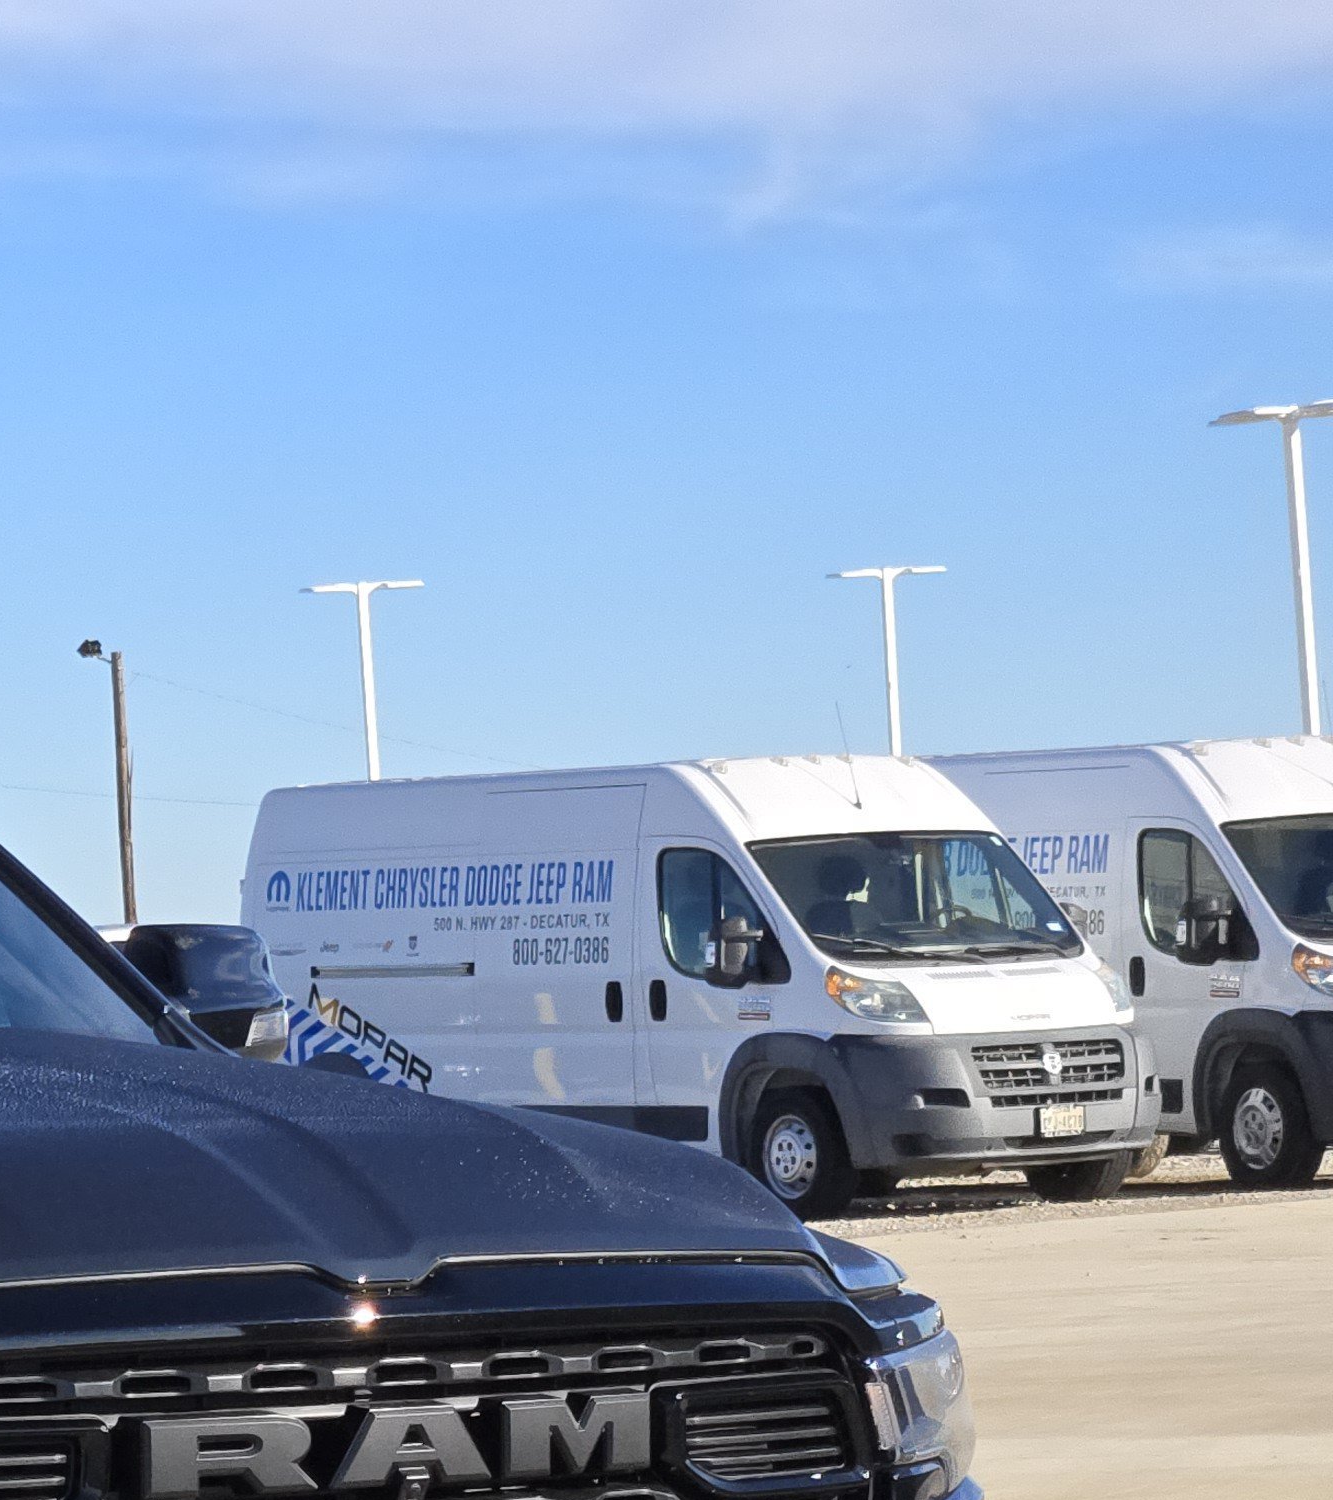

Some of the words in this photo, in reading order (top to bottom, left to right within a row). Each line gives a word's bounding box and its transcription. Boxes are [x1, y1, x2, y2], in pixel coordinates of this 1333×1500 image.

[1067, 834, 1109, 874] RAM
[296, 869, 370, 912] KLEMENT
[374, 866, 459, 910] CHRYSLER
[464, 863, 523, 906] DODGE
[527, 862, 566, 904] JEEP
[571, 860, 614, 903] RAM
[1046, 886, 1089, 900] ECATUR,
[1094, 886, 1106, 898] TX
[433, 917, 452, 931] 500
[455, 917, 467, 931] N.
[471, 916, 497, 931] HWY
[500, 915, 520, 930] 287
[530, 913, 591, 930] DECATUR,
[595, 912, 610, 927] TX
[513, 936, 610, 966] 800-627-0386
[308, 983, 432, 1093] MOPAR
[141, 1389, 653, 1500] RAM
